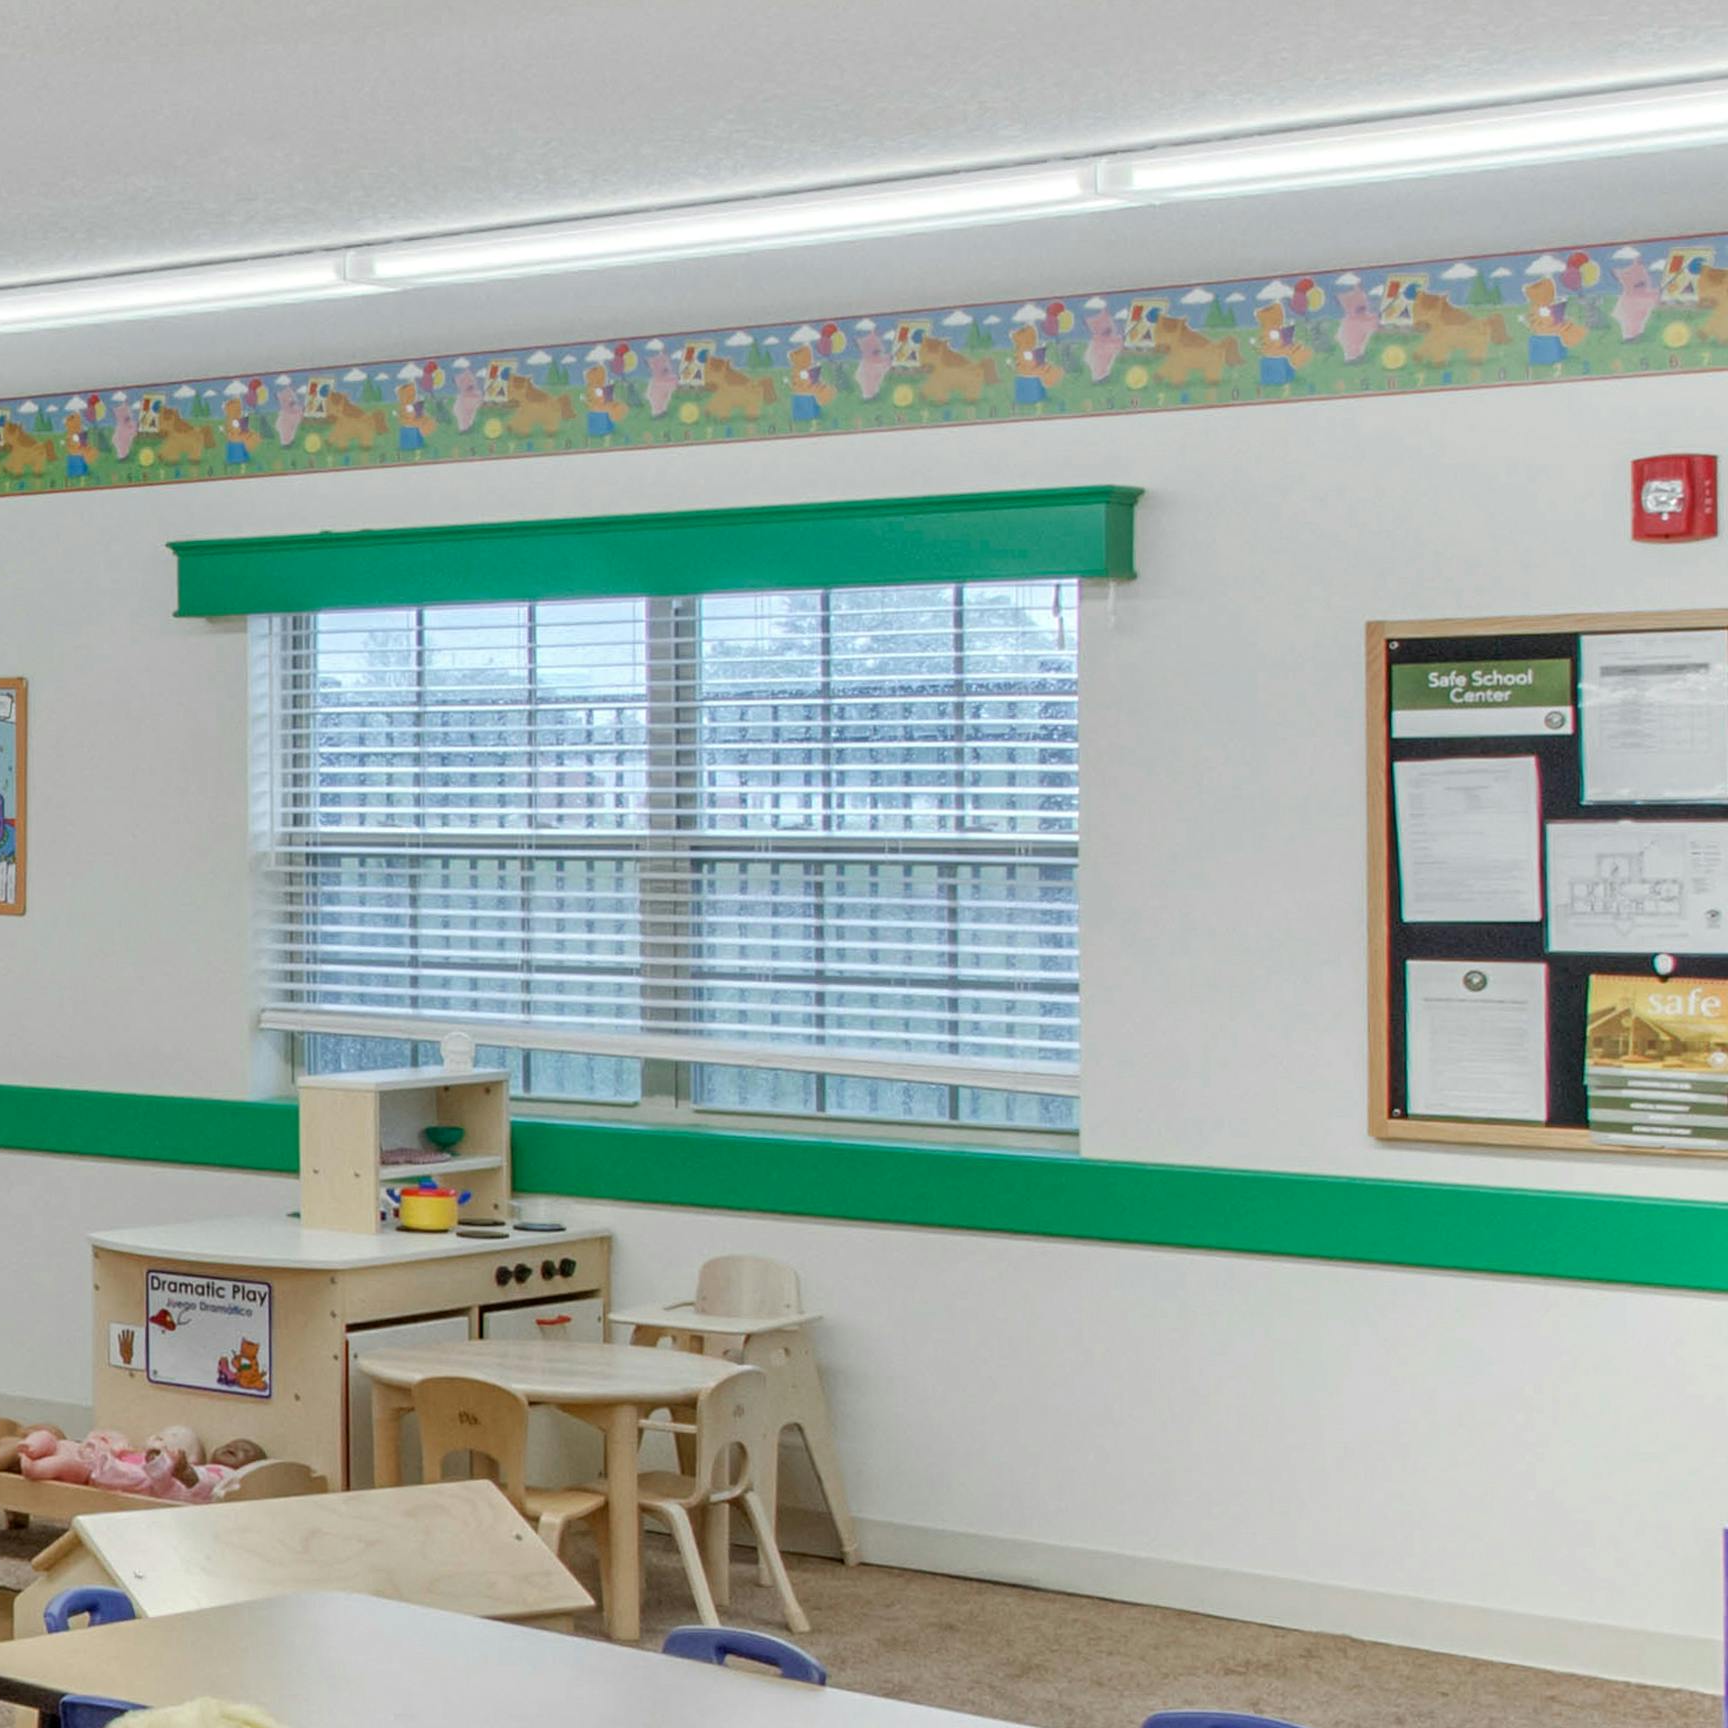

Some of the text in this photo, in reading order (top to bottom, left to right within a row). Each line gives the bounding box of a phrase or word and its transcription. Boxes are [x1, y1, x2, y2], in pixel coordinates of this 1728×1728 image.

[1427, 667, 1534, 689] Safe School
[1448, 688, 1512, 704] Center
[1647, 986, 1722, 1019] safe
[150, 1275, 268, 1307] Dramatic Play
[166, 1299, 197, 1312] Juego
